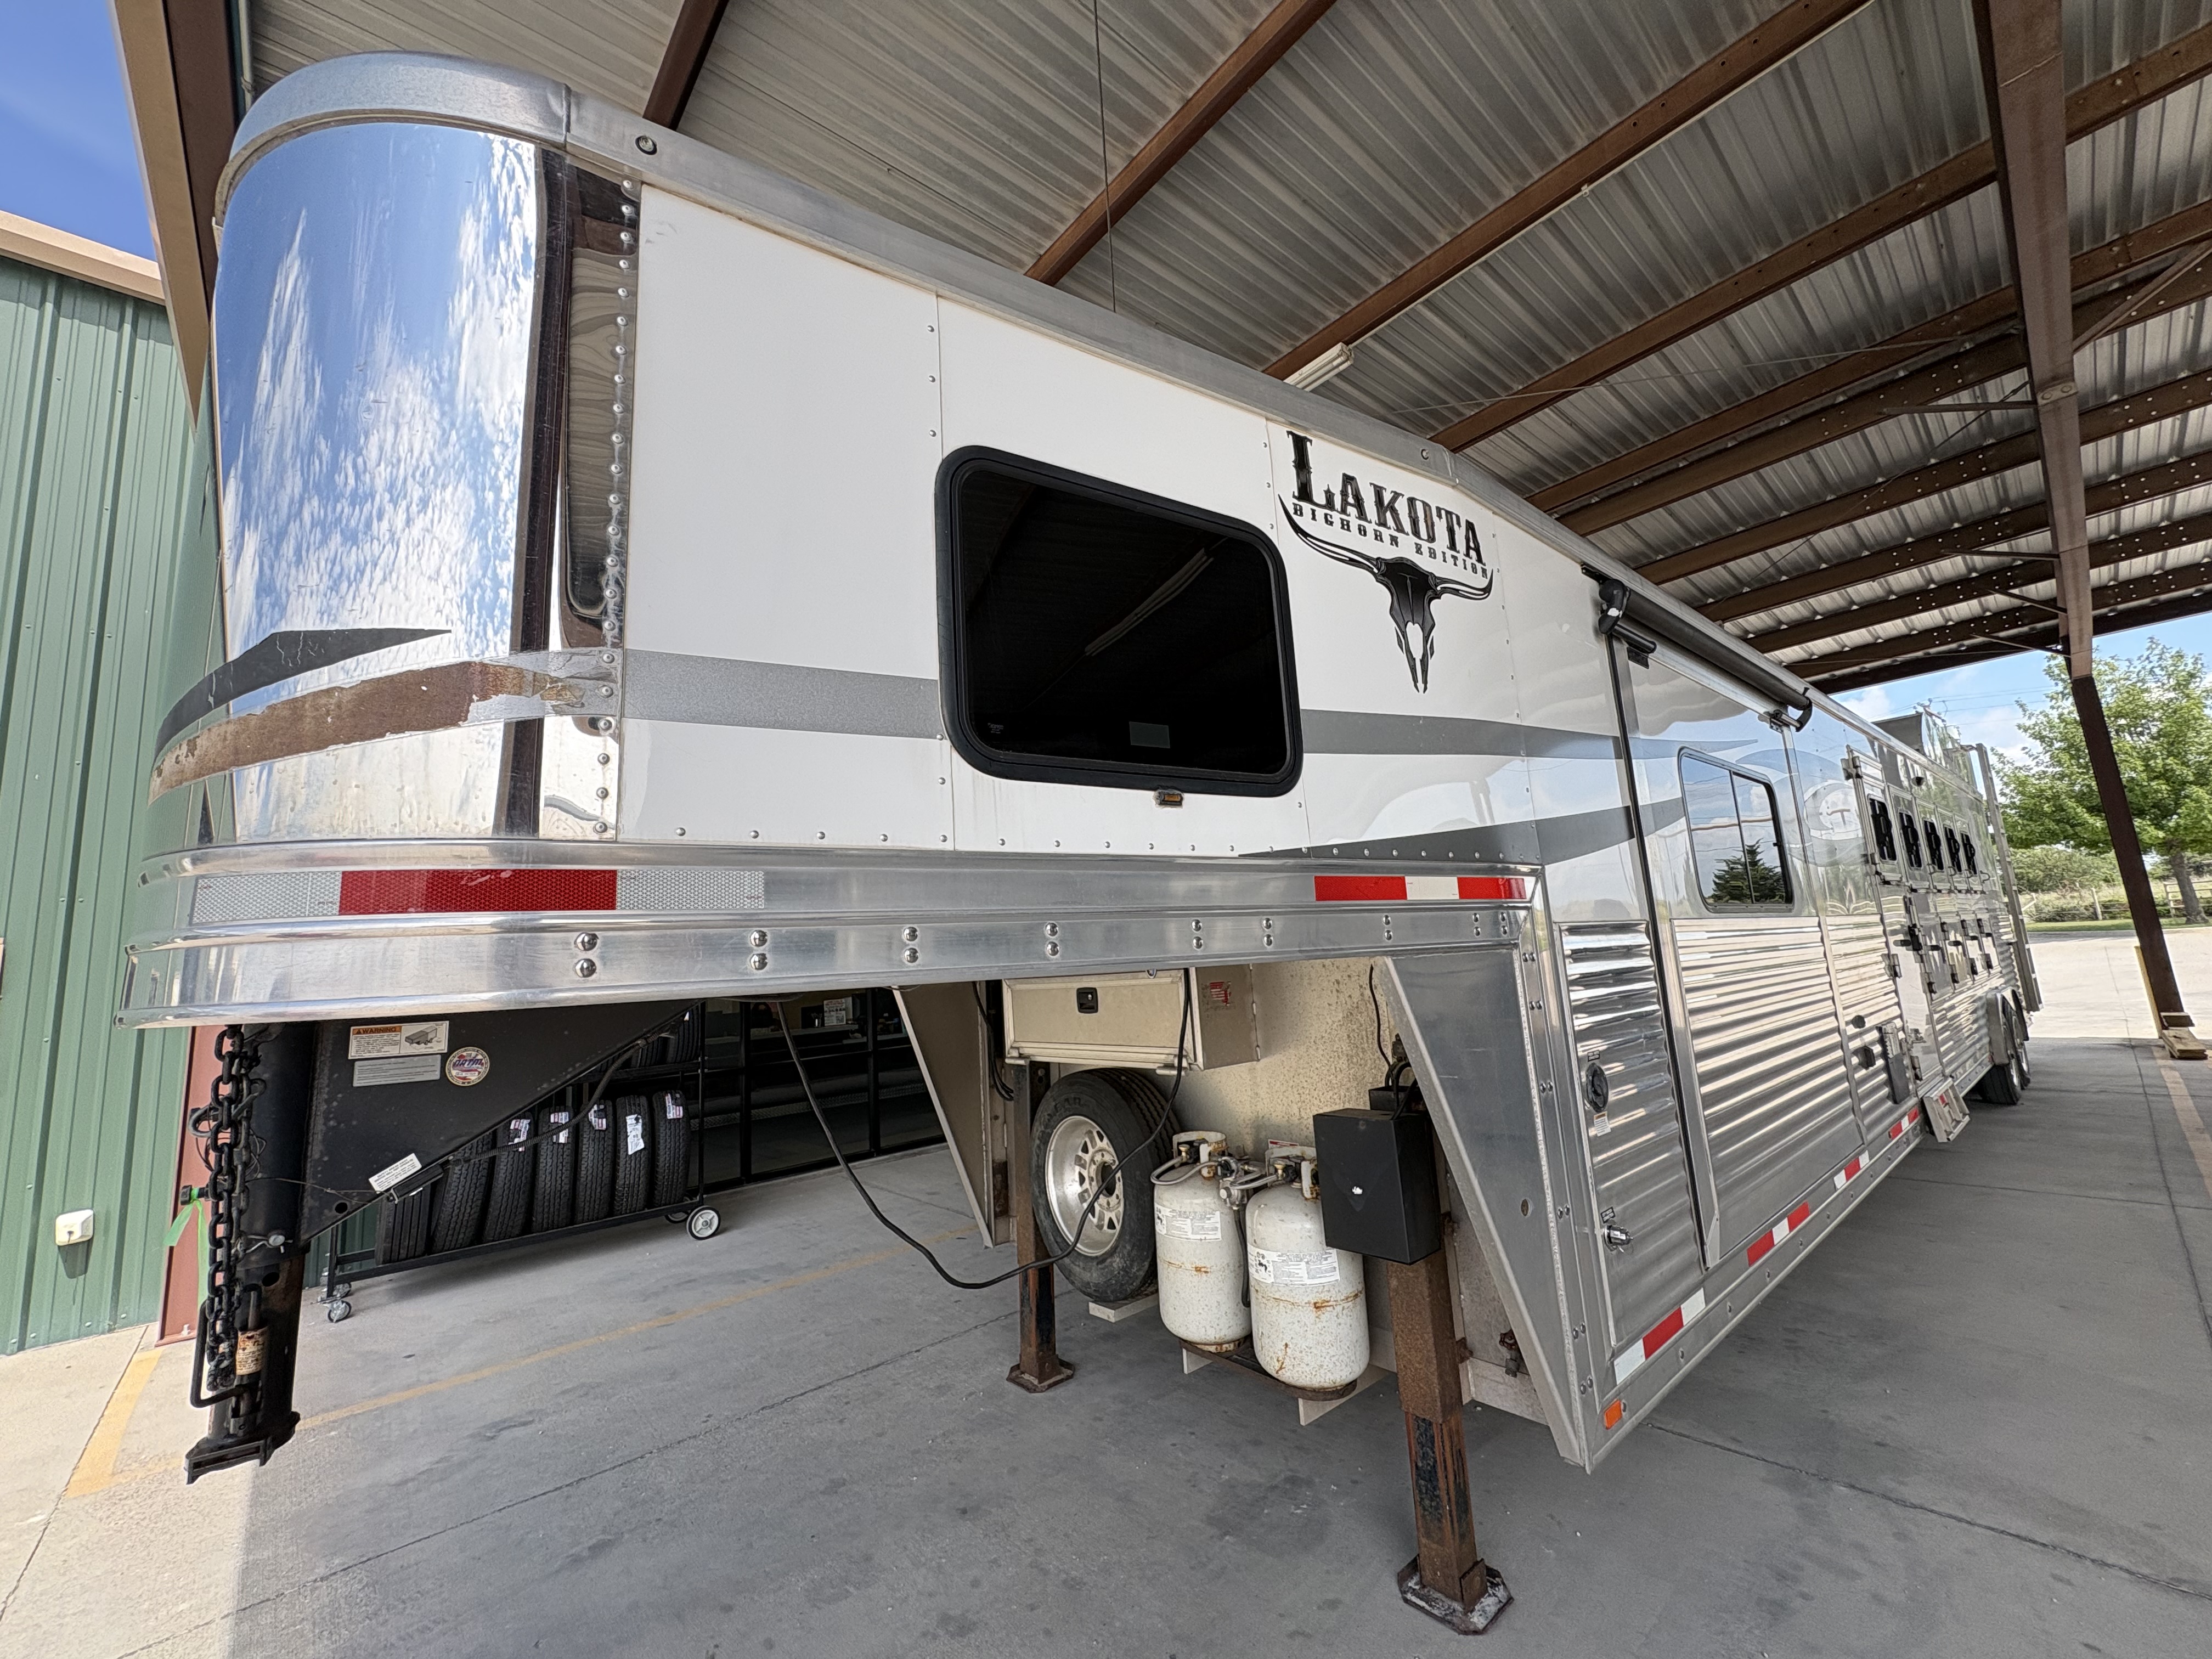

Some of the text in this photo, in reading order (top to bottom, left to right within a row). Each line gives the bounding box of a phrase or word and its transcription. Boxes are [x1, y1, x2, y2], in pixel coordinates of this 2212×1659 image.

[1286, 430, 1486, 567] LAKOTA
[1292, 502, 1488, 579] BIGHORN EDITION
